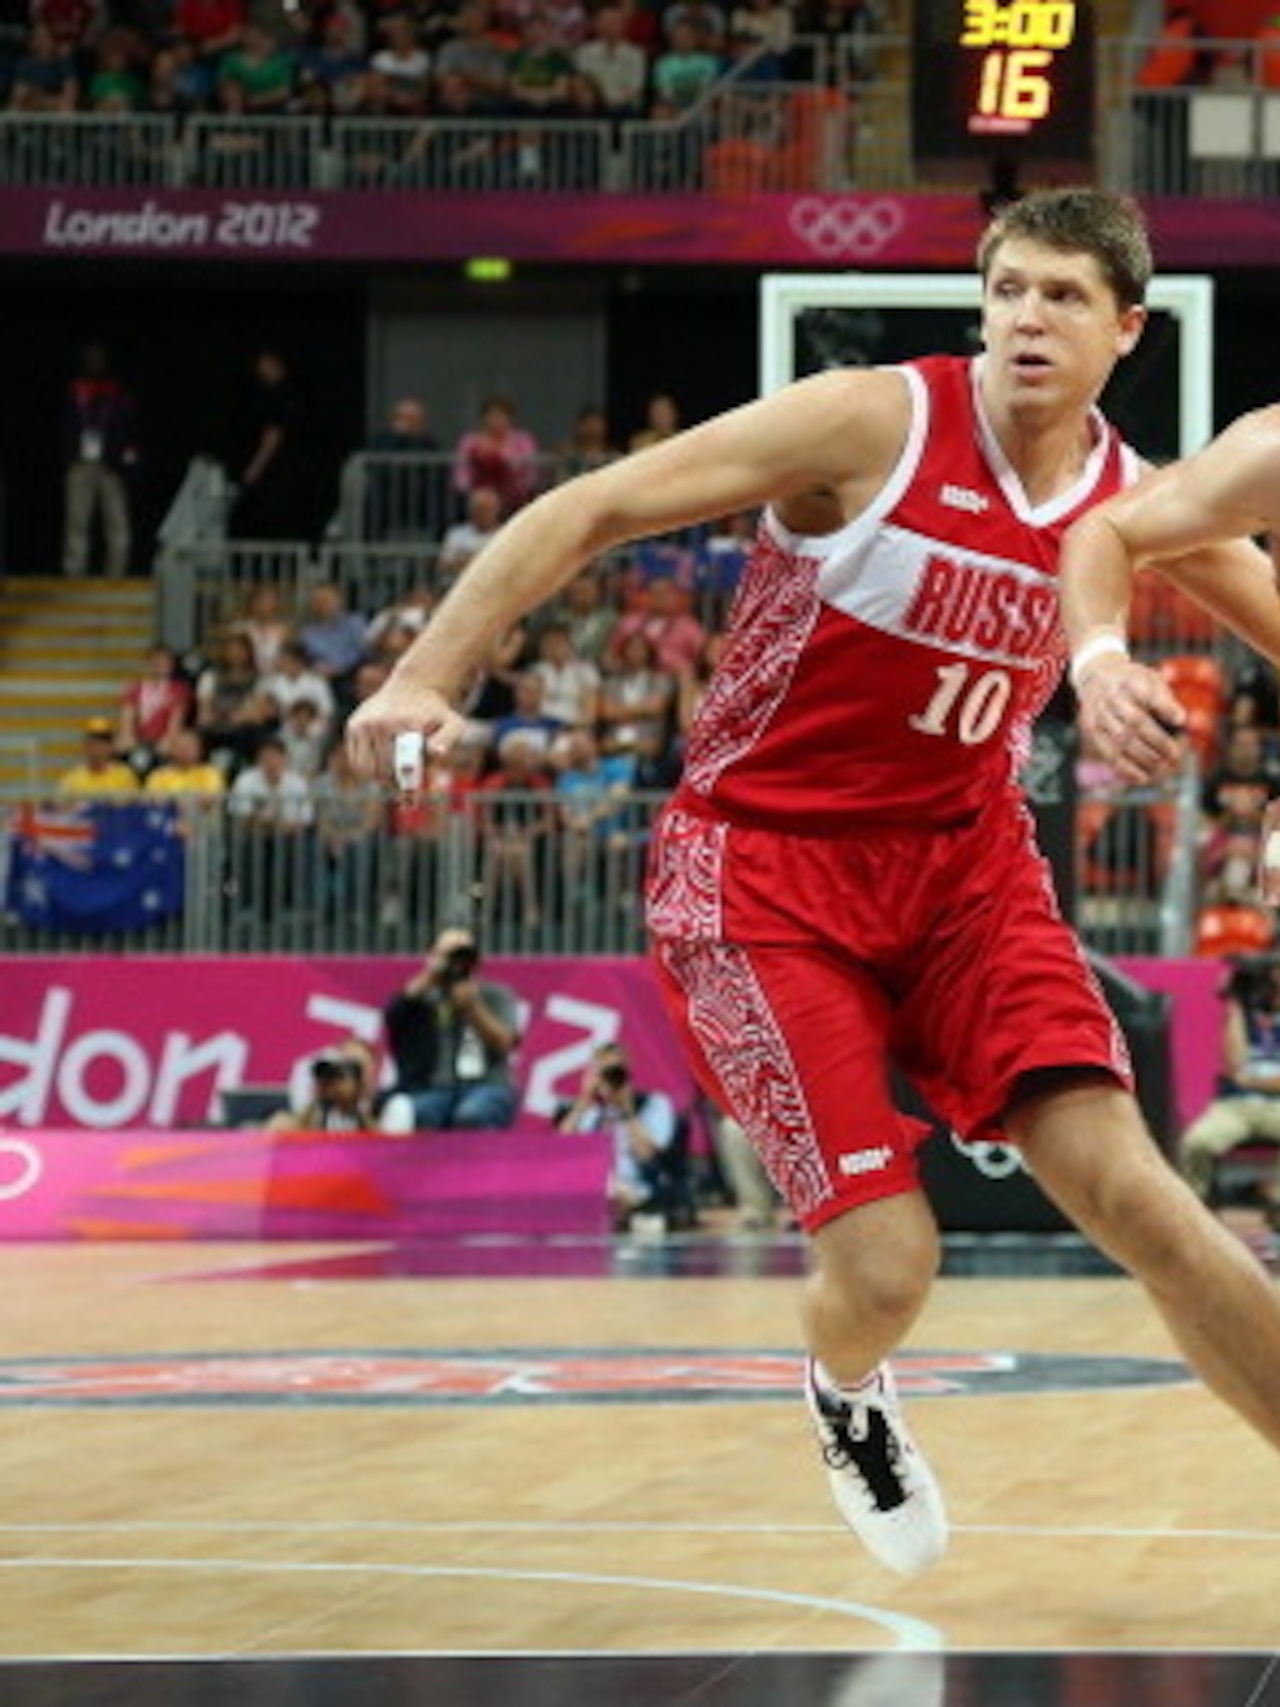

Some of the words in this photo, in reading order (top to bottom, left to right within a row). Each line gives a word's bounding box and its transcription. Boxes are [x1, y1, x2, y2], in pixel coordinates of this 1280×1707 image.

[960, 0, 1076, 47] 3:00
[979, 50, 1053, 119] 16
[44, 201, 208, 246] London
[215, 203, 320, 247] 2012
[907, 662, 1012, 746] 10
